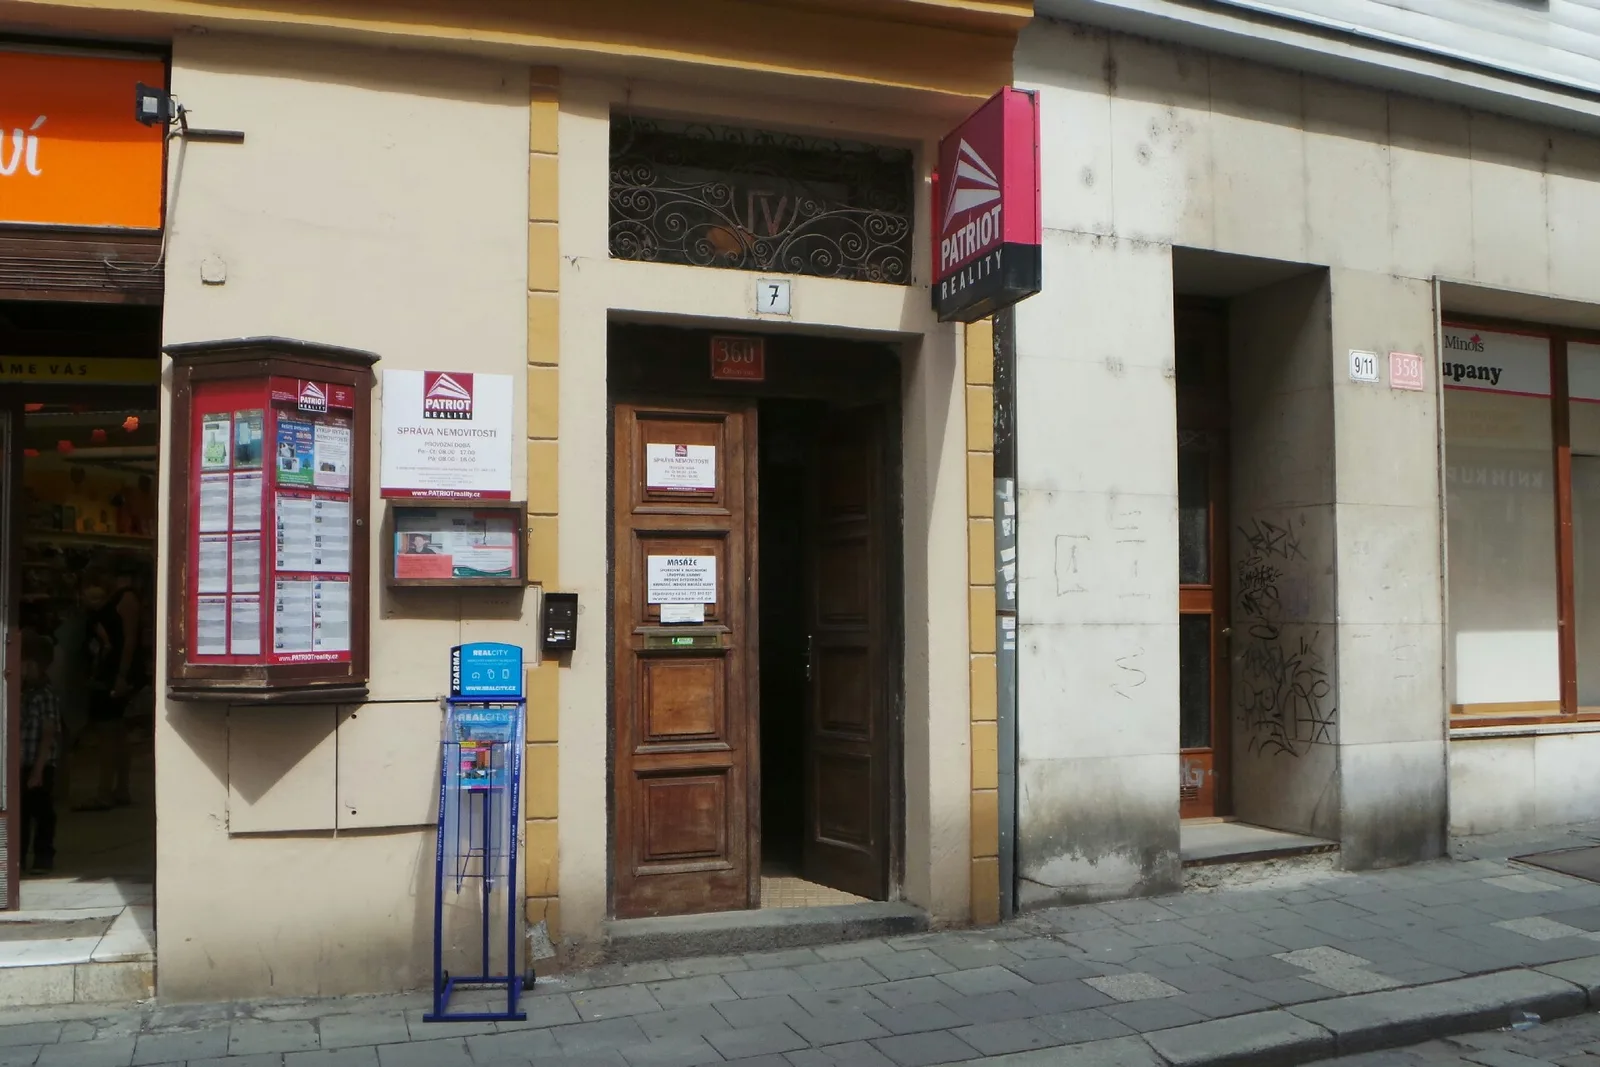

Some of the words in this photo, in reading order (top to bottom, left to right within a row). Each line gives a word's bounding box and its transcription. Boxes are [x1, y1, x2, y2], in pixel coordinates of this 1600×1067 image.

[941, 203, 1002, 272] PATRIOT
[942, 248, 1002, 300] REALITY
[768, 284, 780, 306] 7
[717, 341, 755, 363] 360
[1354, 356, 1374, 375] 9/11
[1394, 357, 1418, 378] 358
[300, 396, 326, 405] PATRIOT
[425, 399, 471, 410] PATRIOT
[425, 411, 471, 419] REALITY
[397, 425, 434, 436] SPRÁVA
[411, 489, 480, 498] www.PATRIOTreality.cz
[666, 557, 697, 566] MASÁŽE
[278, 653, 338, 661] www.PATRIOTreality.cz
